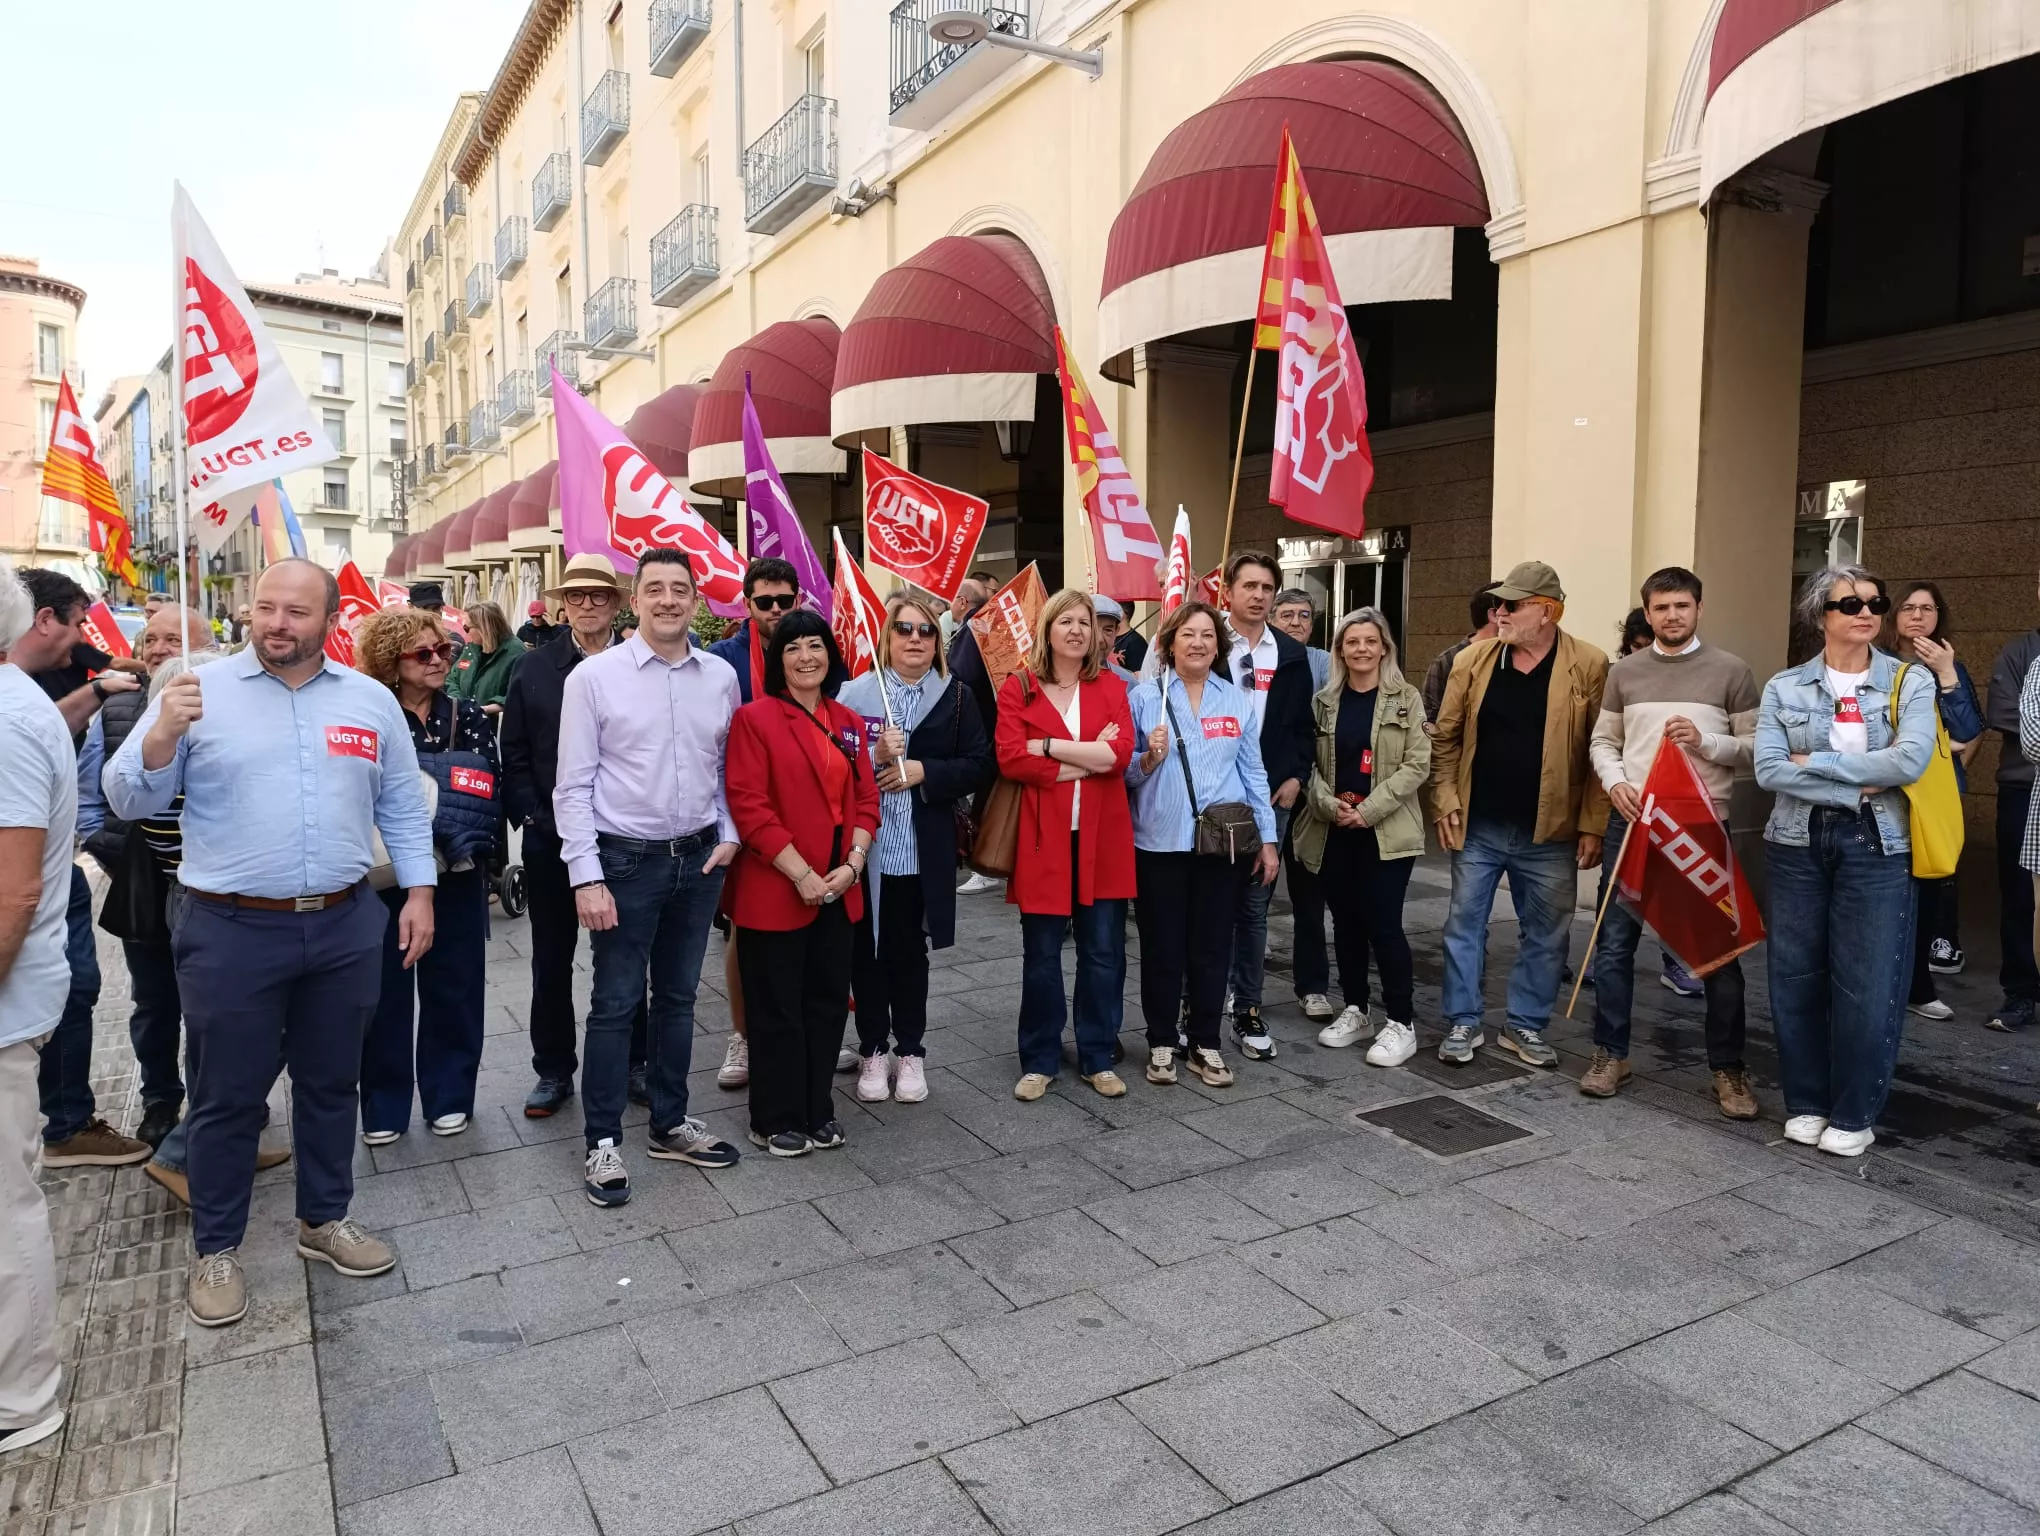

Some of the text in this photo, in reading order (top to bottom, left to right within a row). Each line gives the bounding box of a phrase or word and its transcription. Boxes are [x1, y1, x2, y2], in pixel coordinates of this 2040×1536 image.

[393, 460, 402, 519] HOSTAL
[1798, 488, 1850, 515] MA
[876, 484, 939, 541] UGT
[939, 506, 976, 590] www.UGT.es
[998, 588, 1034, 656] CCOO
[330, 733, 360, 745] UGT
[1204, 721, 1225, 731] UGT
[469, 779, 490, 793] UGT
